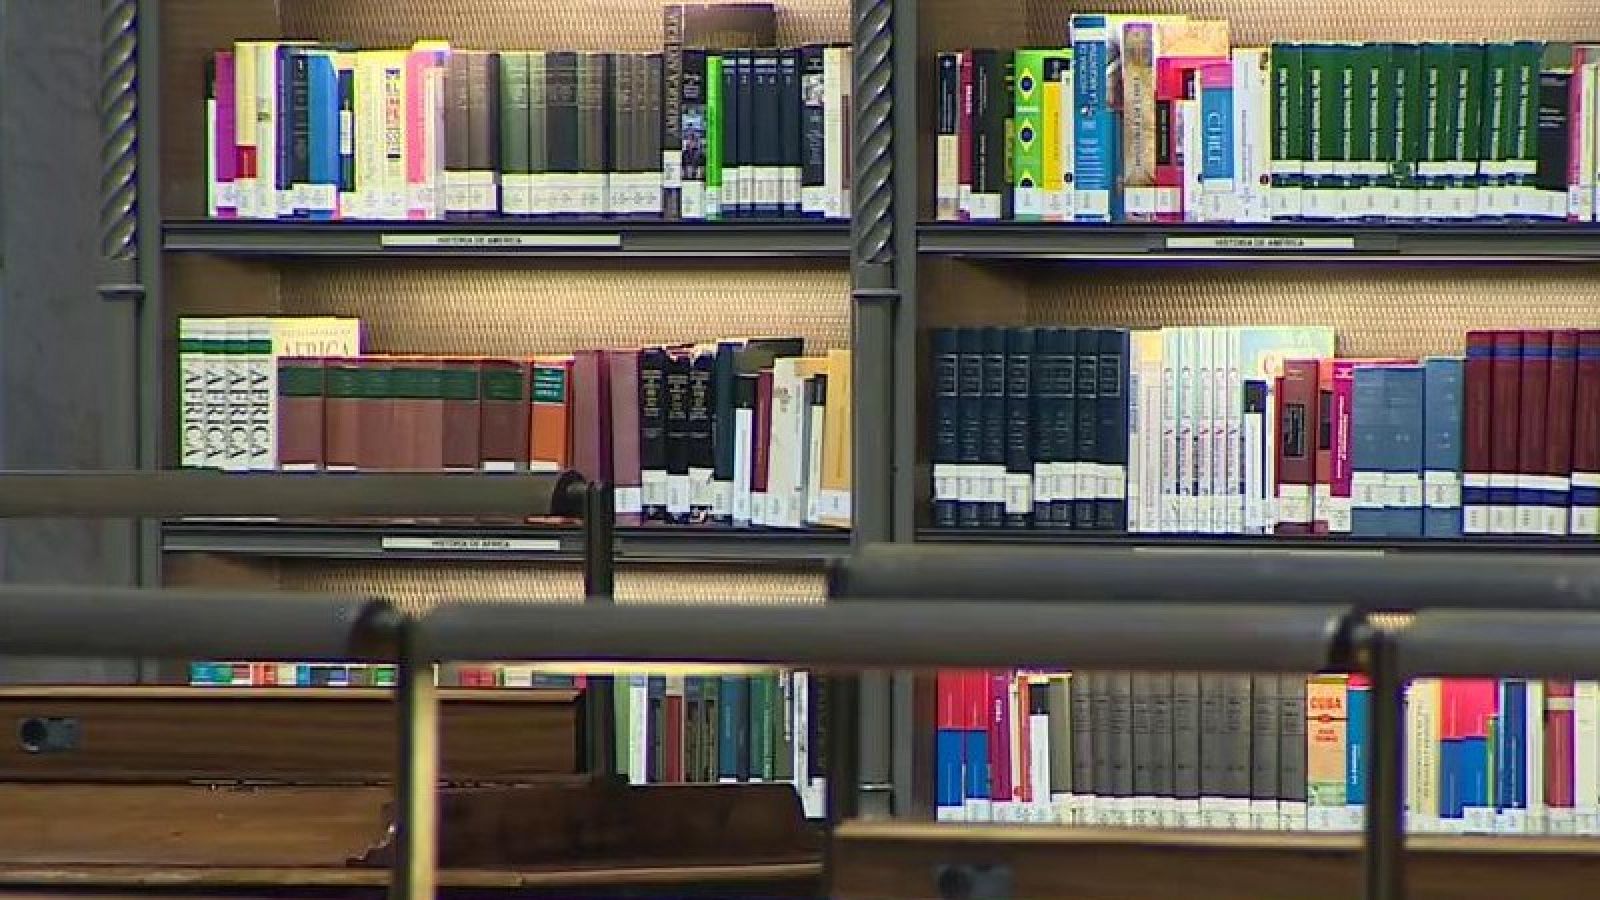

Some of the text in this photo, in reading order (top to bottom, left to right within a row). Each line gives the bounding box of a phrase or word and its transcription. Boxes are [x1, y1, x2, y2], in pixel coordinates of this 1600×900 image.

[186, 370, 203, 457] AFRICA
[206, 370, 225, 457] AFRICA
[230, 370, 248, 457] AFRICA
[252, 370, 269, 457] AFRICA
